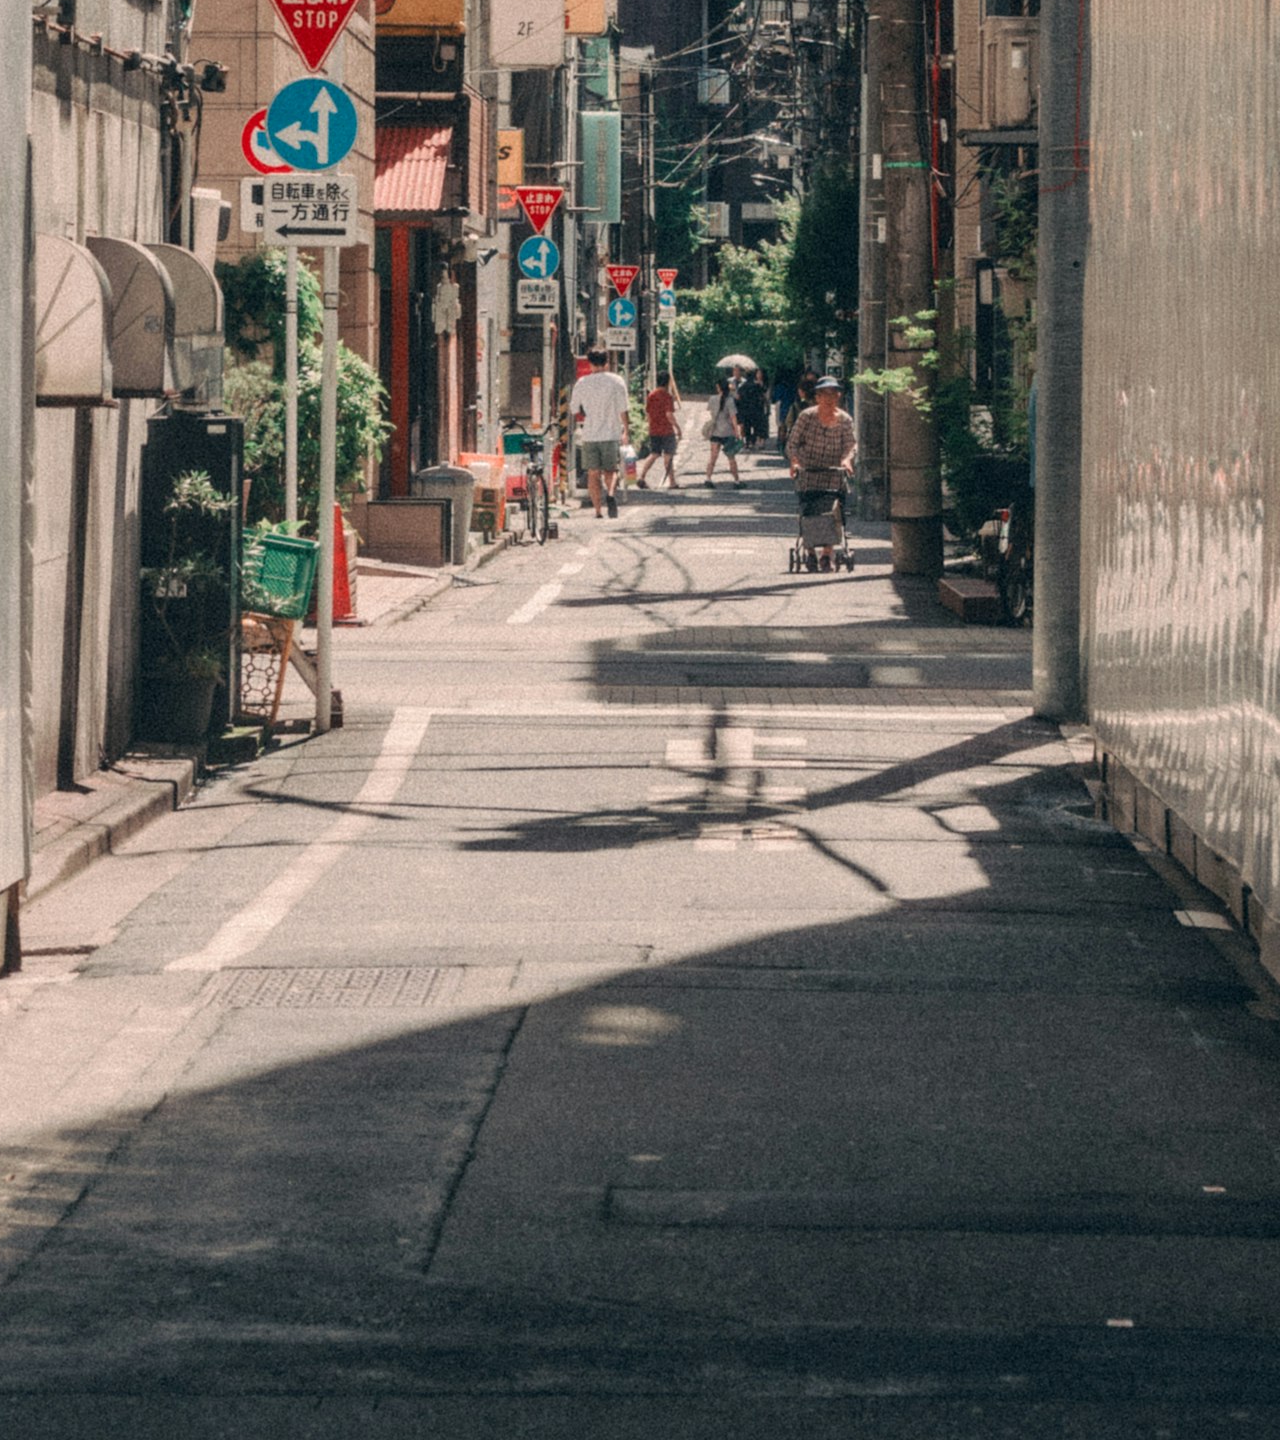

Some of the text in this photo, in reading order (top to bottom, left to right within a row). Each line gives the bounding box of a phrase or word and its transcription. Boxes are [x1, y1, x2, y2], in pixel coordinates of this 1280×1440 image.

[293, 10, 338, 29] STOP
[516, 20, 536, 39] 2F
[271, 182, 350, 200] 自転車を除く
[525, 192, 555, 204] 止まれ
[271, 203, 350, 222] 一方通行
[529, 205, 551, 215] STOP
